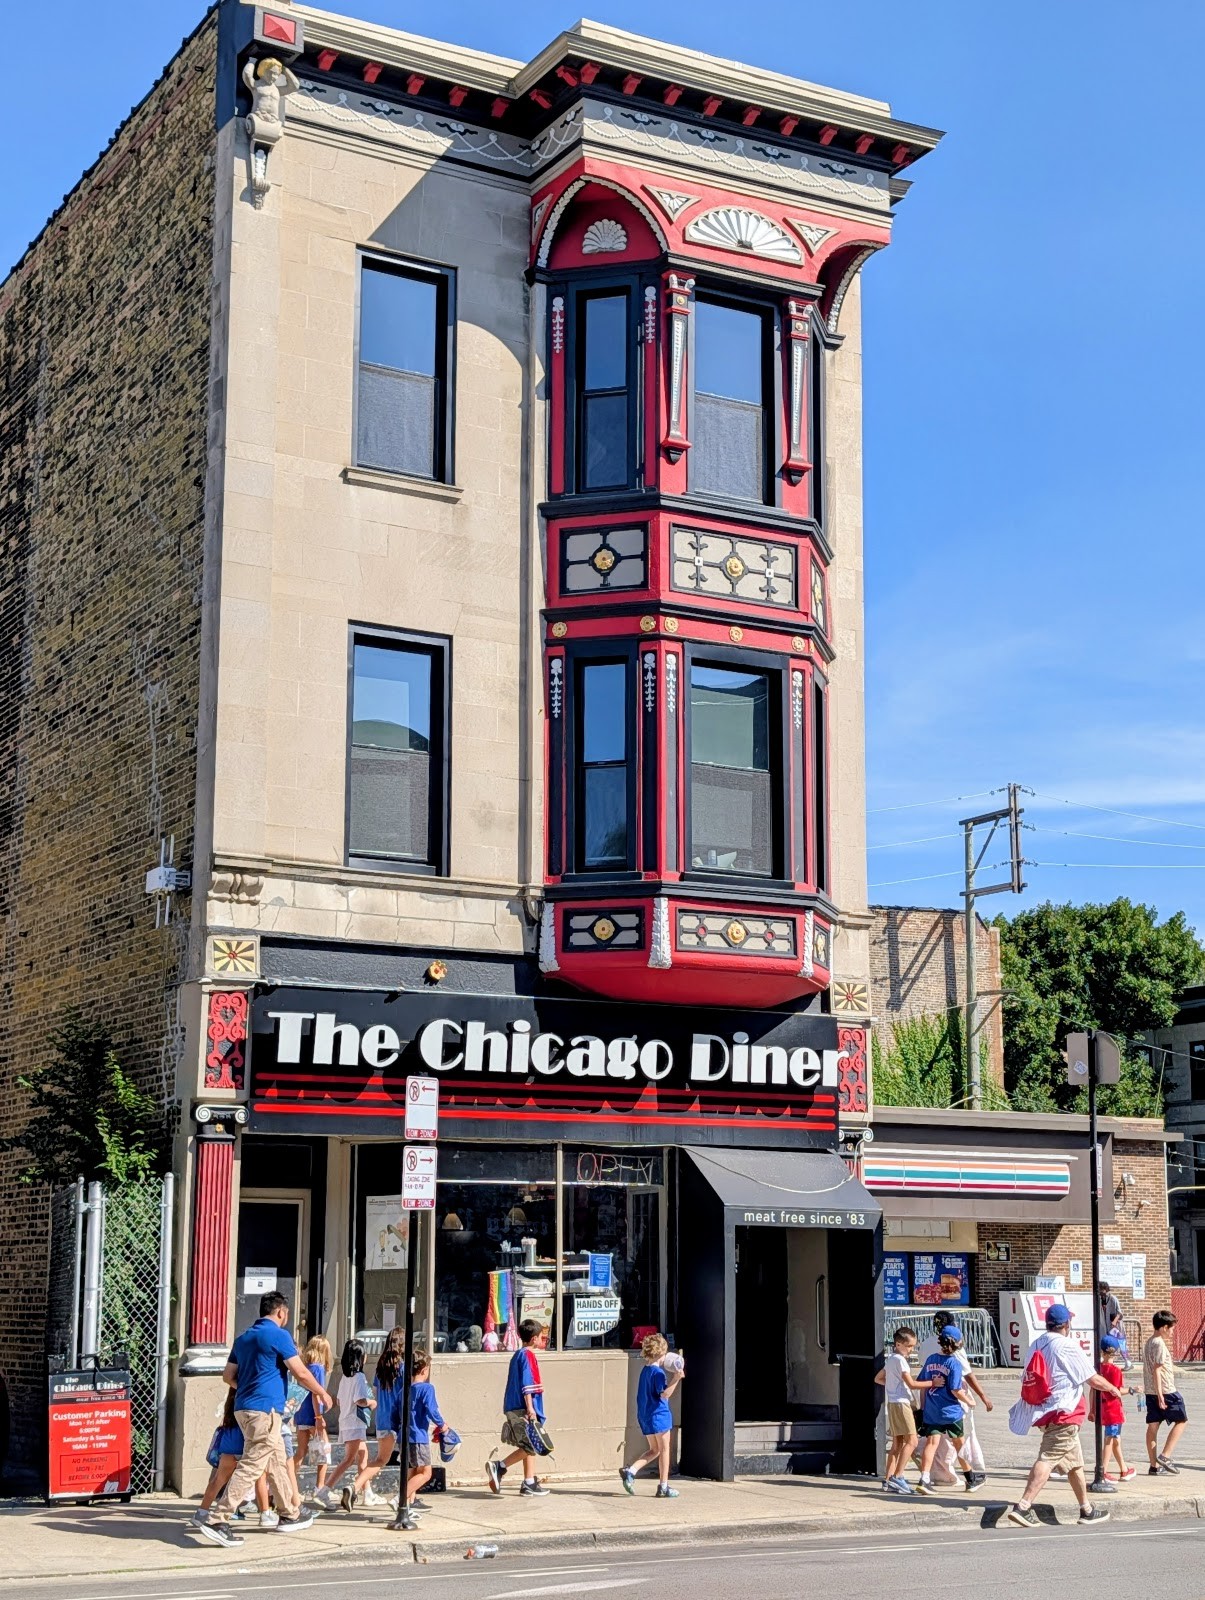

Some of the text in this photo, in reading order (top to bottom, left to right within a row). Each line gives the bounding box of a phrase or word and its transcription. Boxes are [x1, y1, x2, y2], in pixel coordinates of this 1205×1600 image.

[267, 1011, 847, 1087] The Chicago Diner
[744, 1210, 866, 1226] meat free since '83
[883, 1262, 905, 1270] STARTS
[576, 1299, 619, 1309] HANDS OFF
[577, 1320, 618, 1332] CHICAGO
[1009, 1297, 1020, 1362] ICE
[54, 1380, 125, 1393] Chicago Diner
[53, 1409, 127, 1421] Customer Parking
[95, 1418, 111, 1426] After
[63, 1436, 89, 1444] Saturday
